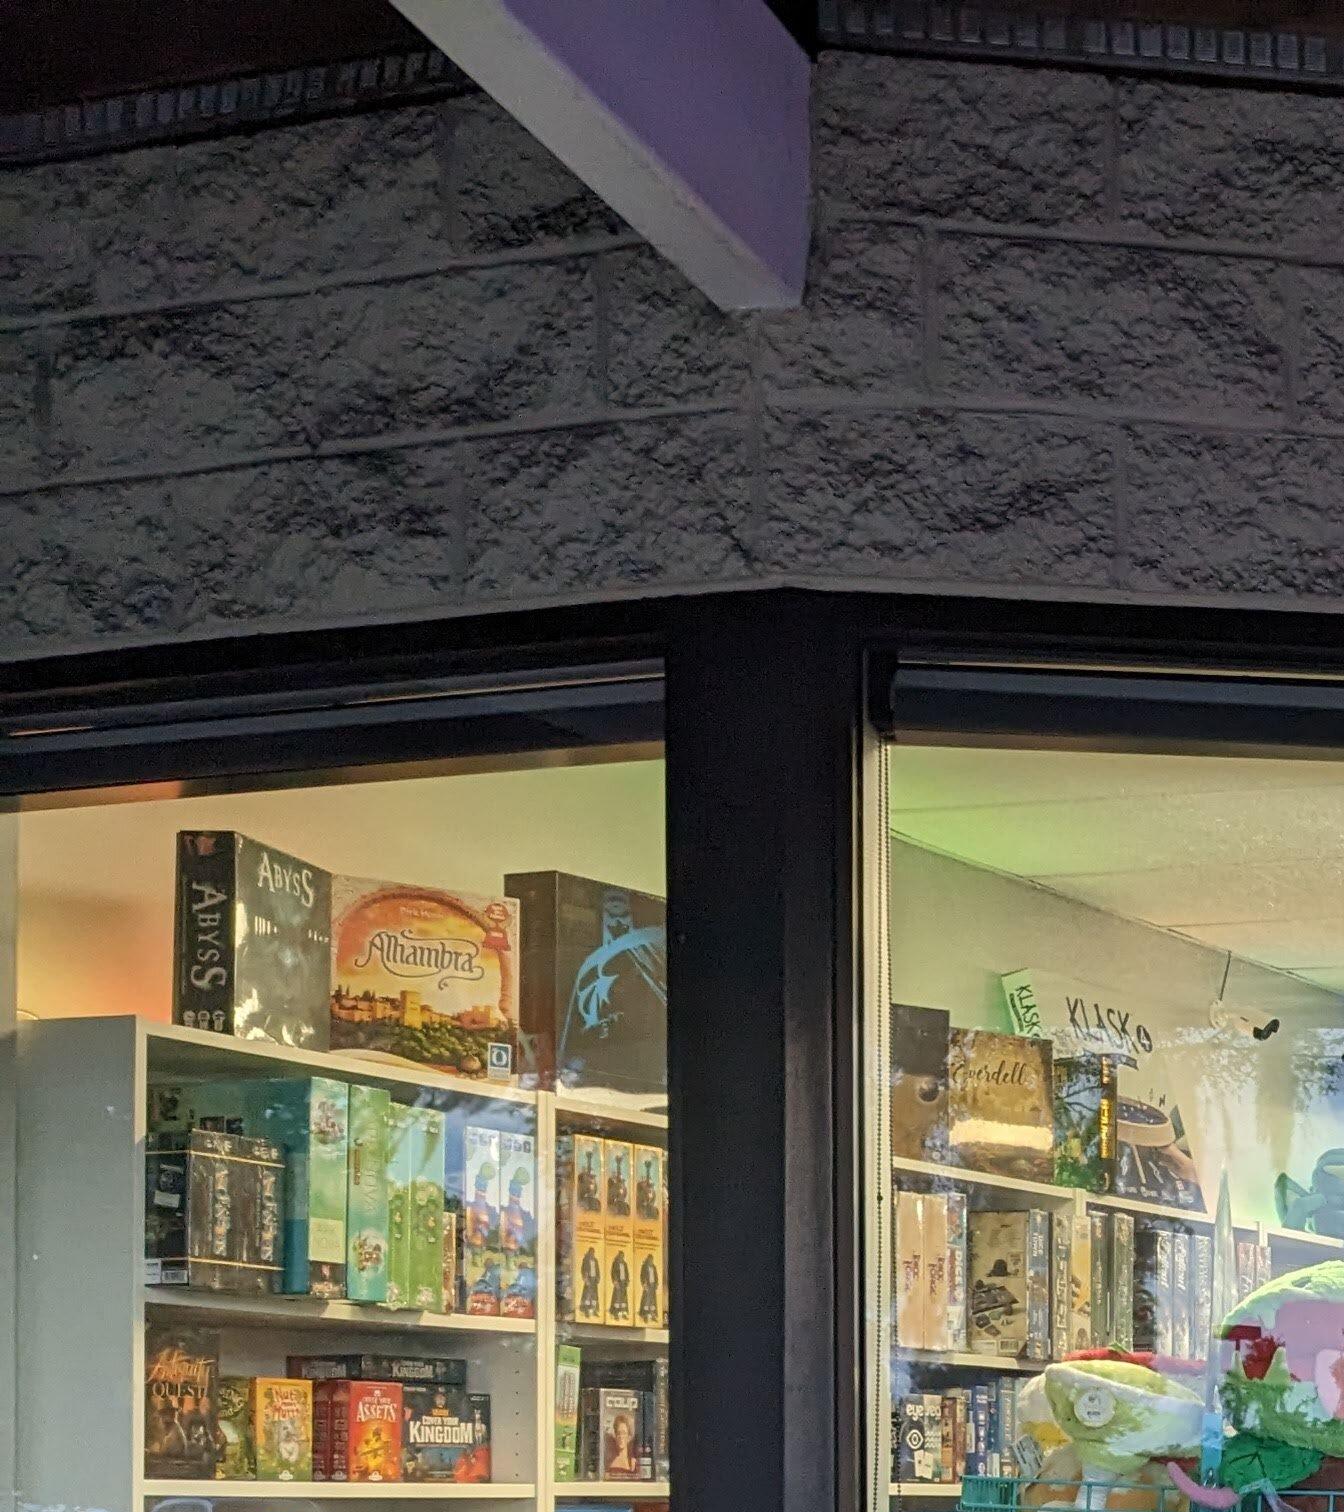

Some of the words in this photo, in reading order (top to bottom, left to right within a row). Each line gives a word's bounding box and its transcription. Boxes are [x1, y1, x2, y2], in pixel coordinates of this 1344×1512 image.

[257, 851, 315, 908] ABYSS
[190, 882, 228, 991] ABYSS
[355, 928, 485, 986] Alhambra
[1015, 984, 1041, 1038] KLASK
[1066, 996, 1139, 1054] KLASK
[951, 1057, 1027, 1087] Everdell
[356, 1401, 398, 1423] ASSETS
[409, 1420, 474, 1444] KINGDOM
